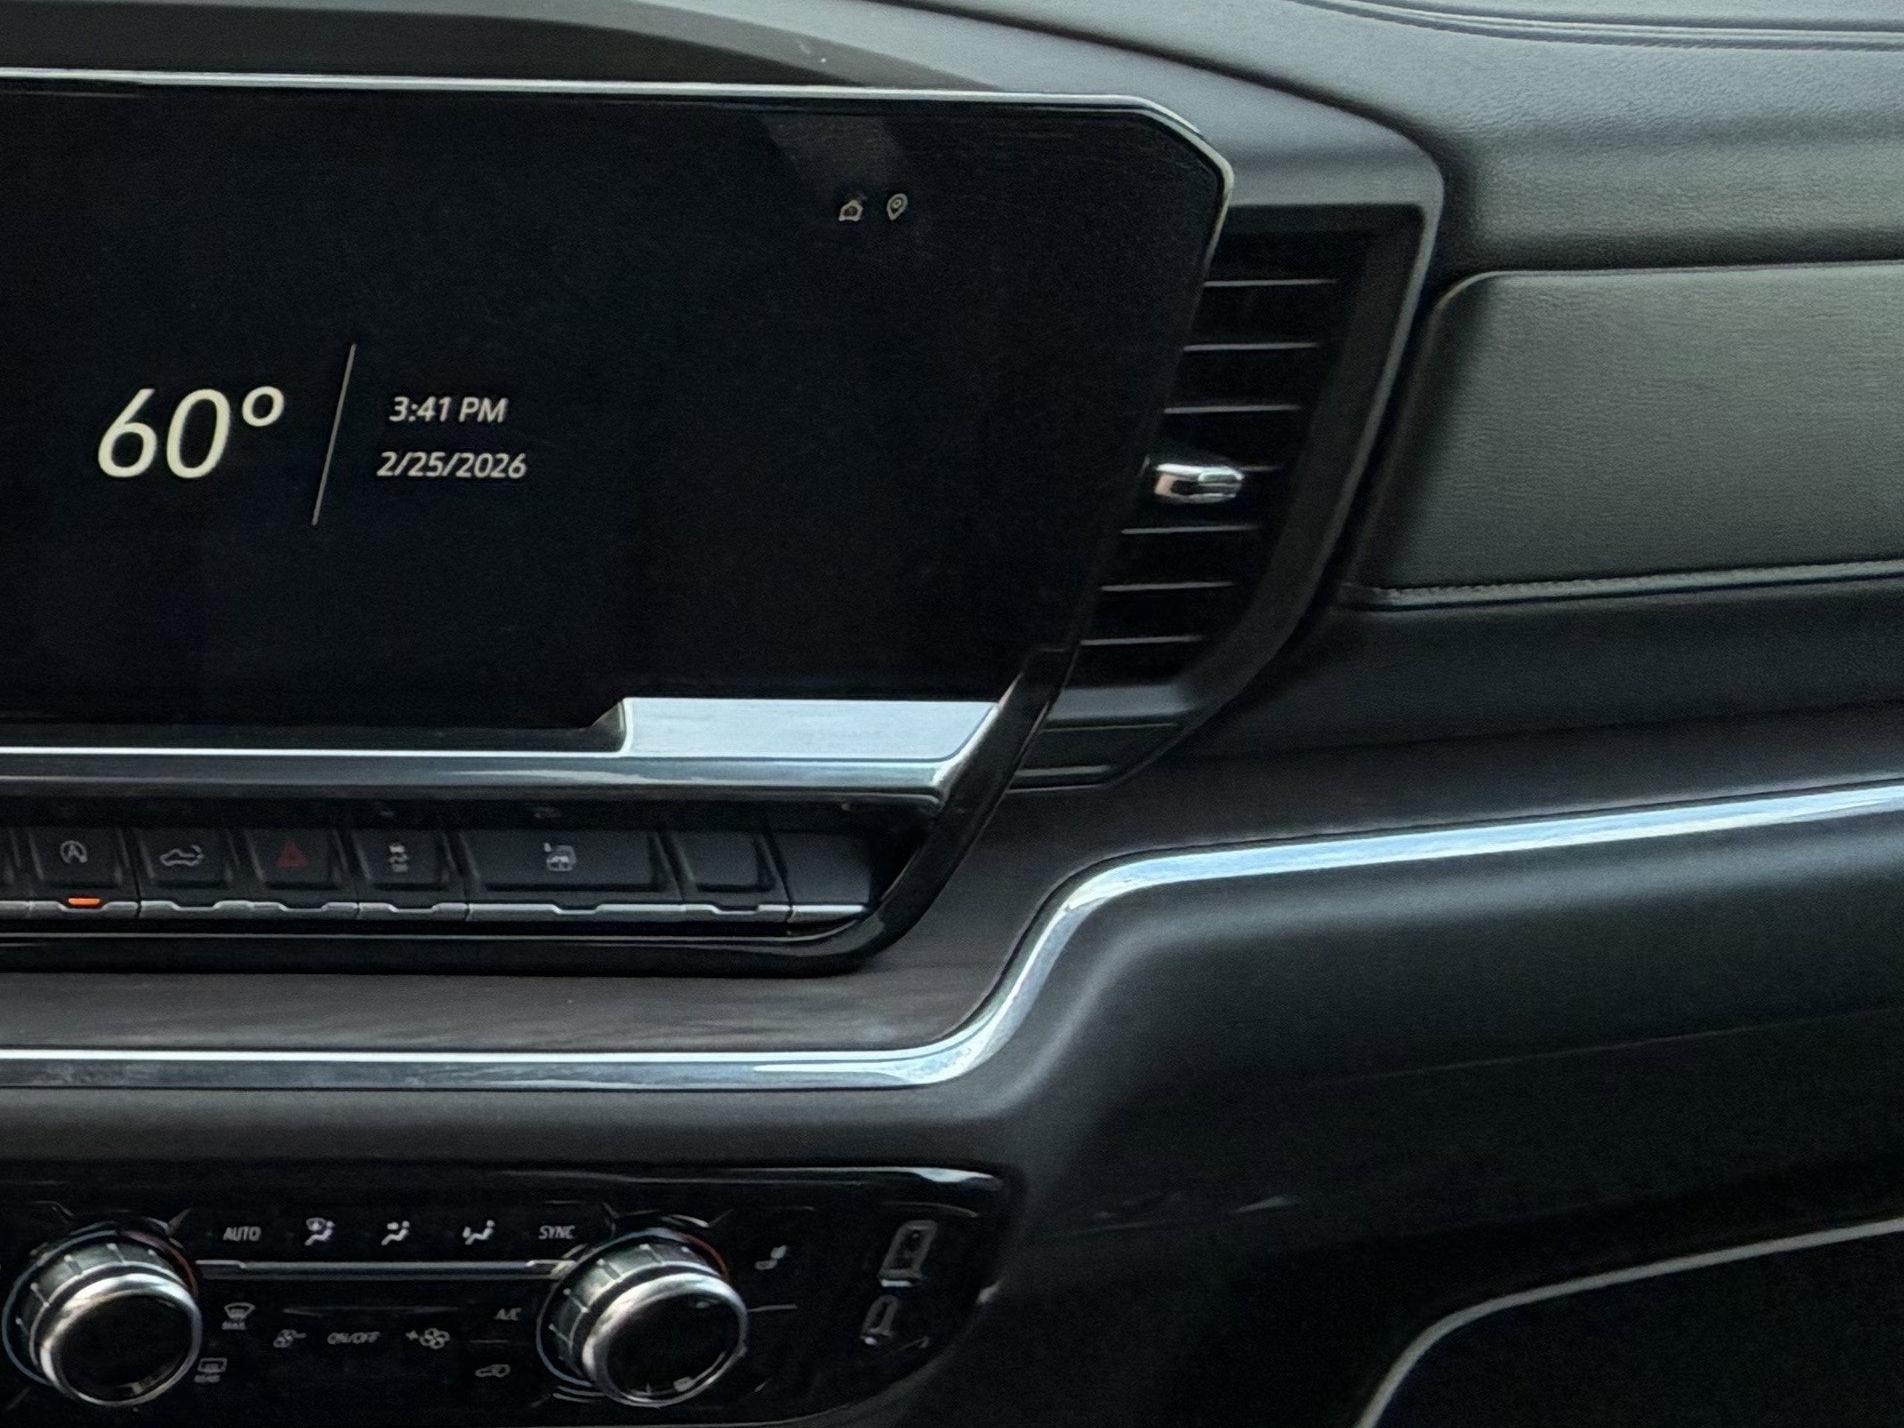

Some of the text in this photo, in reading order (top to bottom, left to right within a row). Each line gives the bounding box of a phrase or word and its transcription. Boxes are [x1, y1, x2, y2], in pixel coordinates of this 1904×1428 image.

[388, 396, 509, 424] 3:41 PM
[97, 385, 285, 480] 60°
[376, 451, 528, 480] 2/25/2026
[222, 1226, 262, 1242] AUTO
[538, 1224, 576, 1240] SYNC
[326, 1330, 381, 1345] ON/OFF
